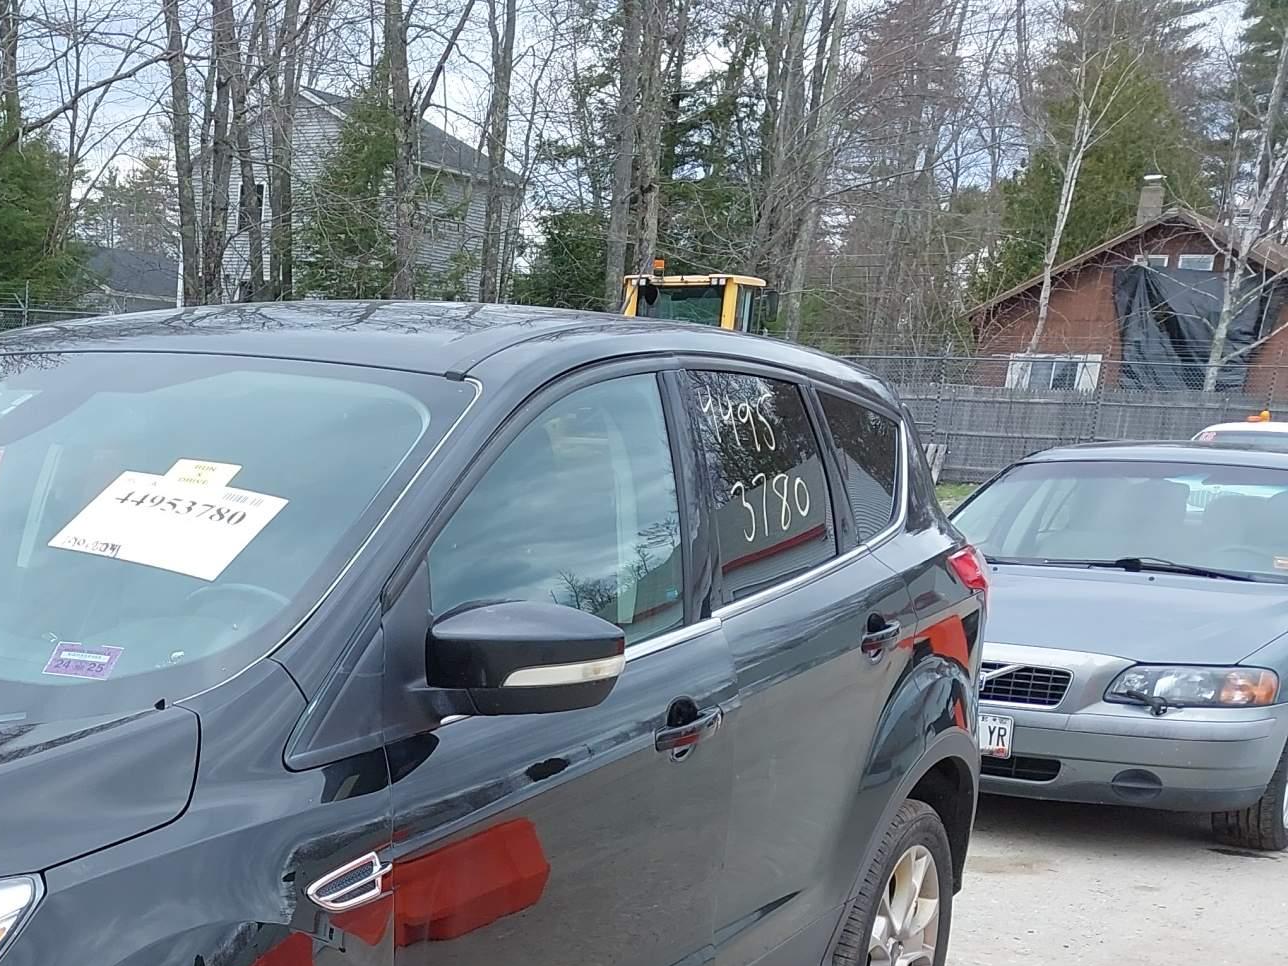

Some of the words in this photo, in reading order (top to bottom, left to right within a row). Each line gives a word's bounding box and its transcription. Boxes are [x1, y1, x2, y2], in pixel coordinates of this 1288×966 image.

[115, 491, 247, 525] 44953780
[730, 472, 810, 542] 3780
[54, 659, 70, 668] 24
[87, 662, 105, 673] 25
[988, 725, 1007, 747] YR
